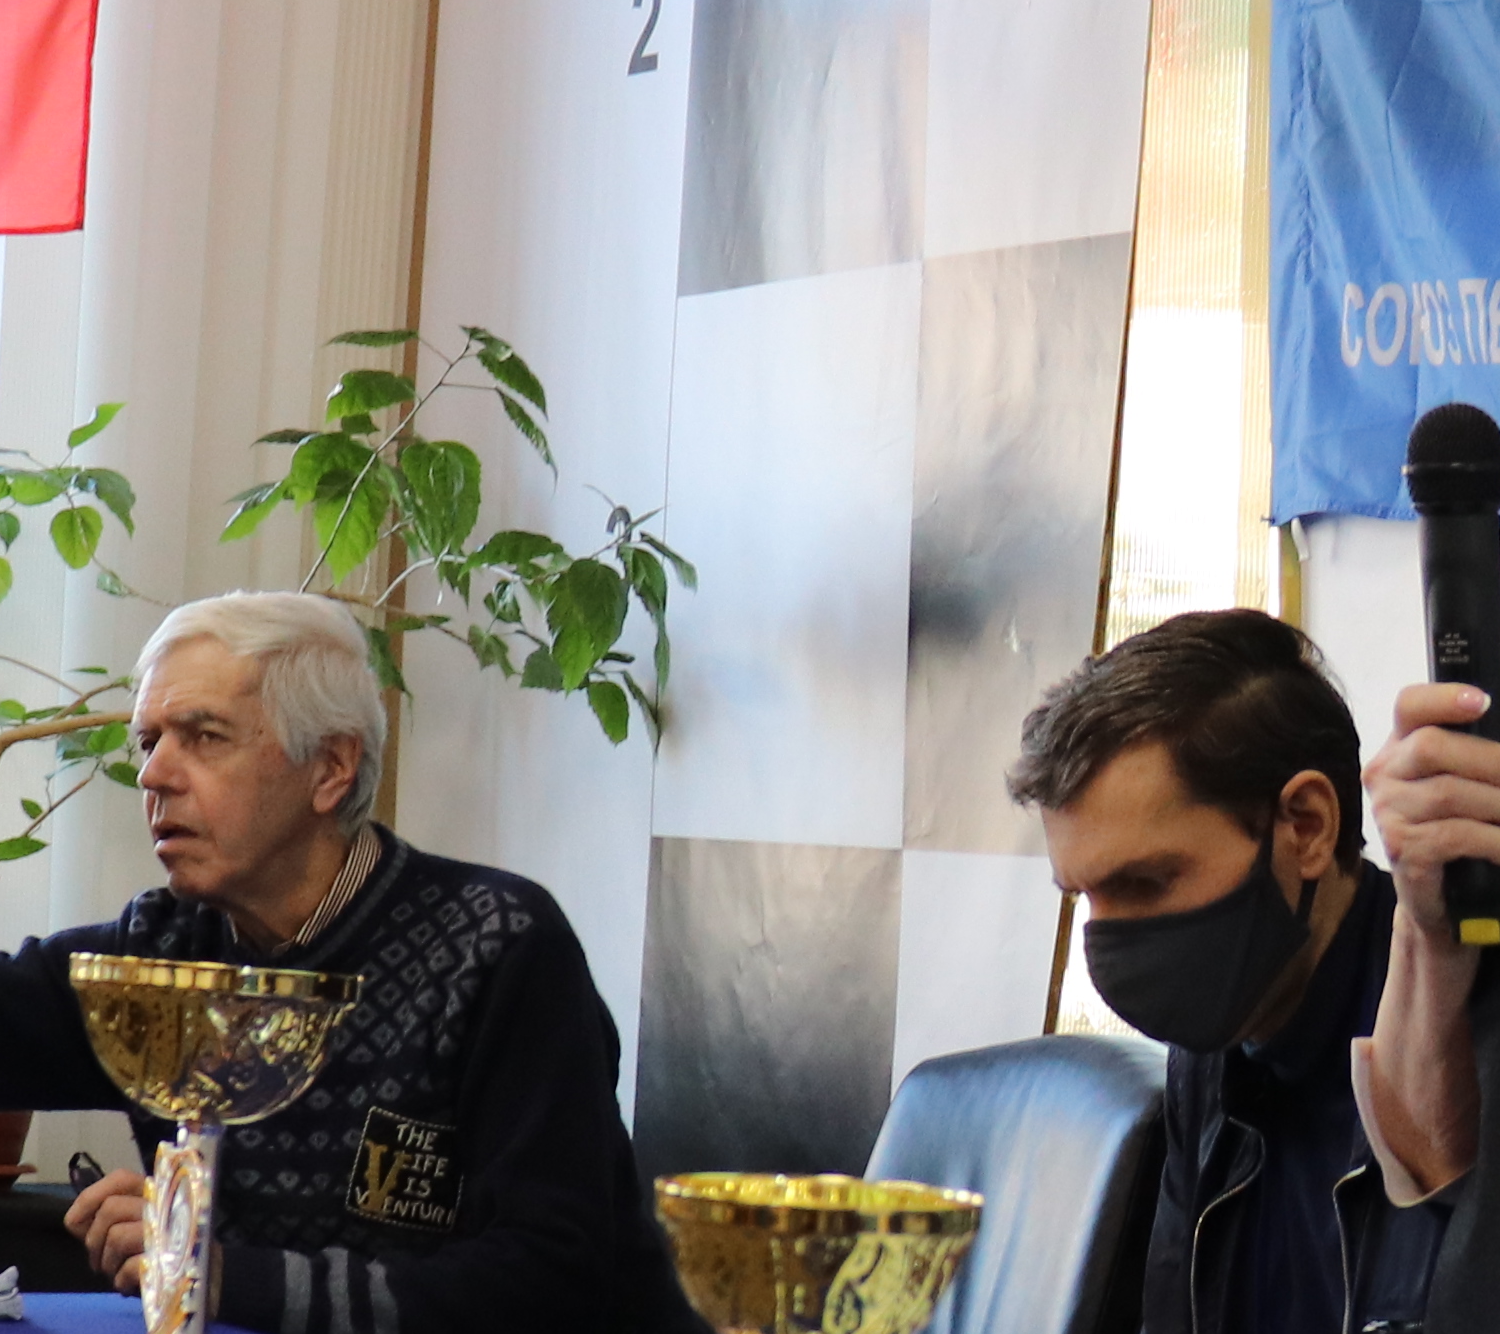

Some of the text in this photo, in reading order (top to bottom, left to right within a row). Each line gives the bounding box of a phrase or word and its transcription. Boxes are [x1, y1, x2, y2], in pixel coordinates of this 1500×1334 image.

[1340, 278, 1462, 367] СОЮЗ
[396, 1123, 438, 1151] THE
[403, 1176, 432, 1199] IS
